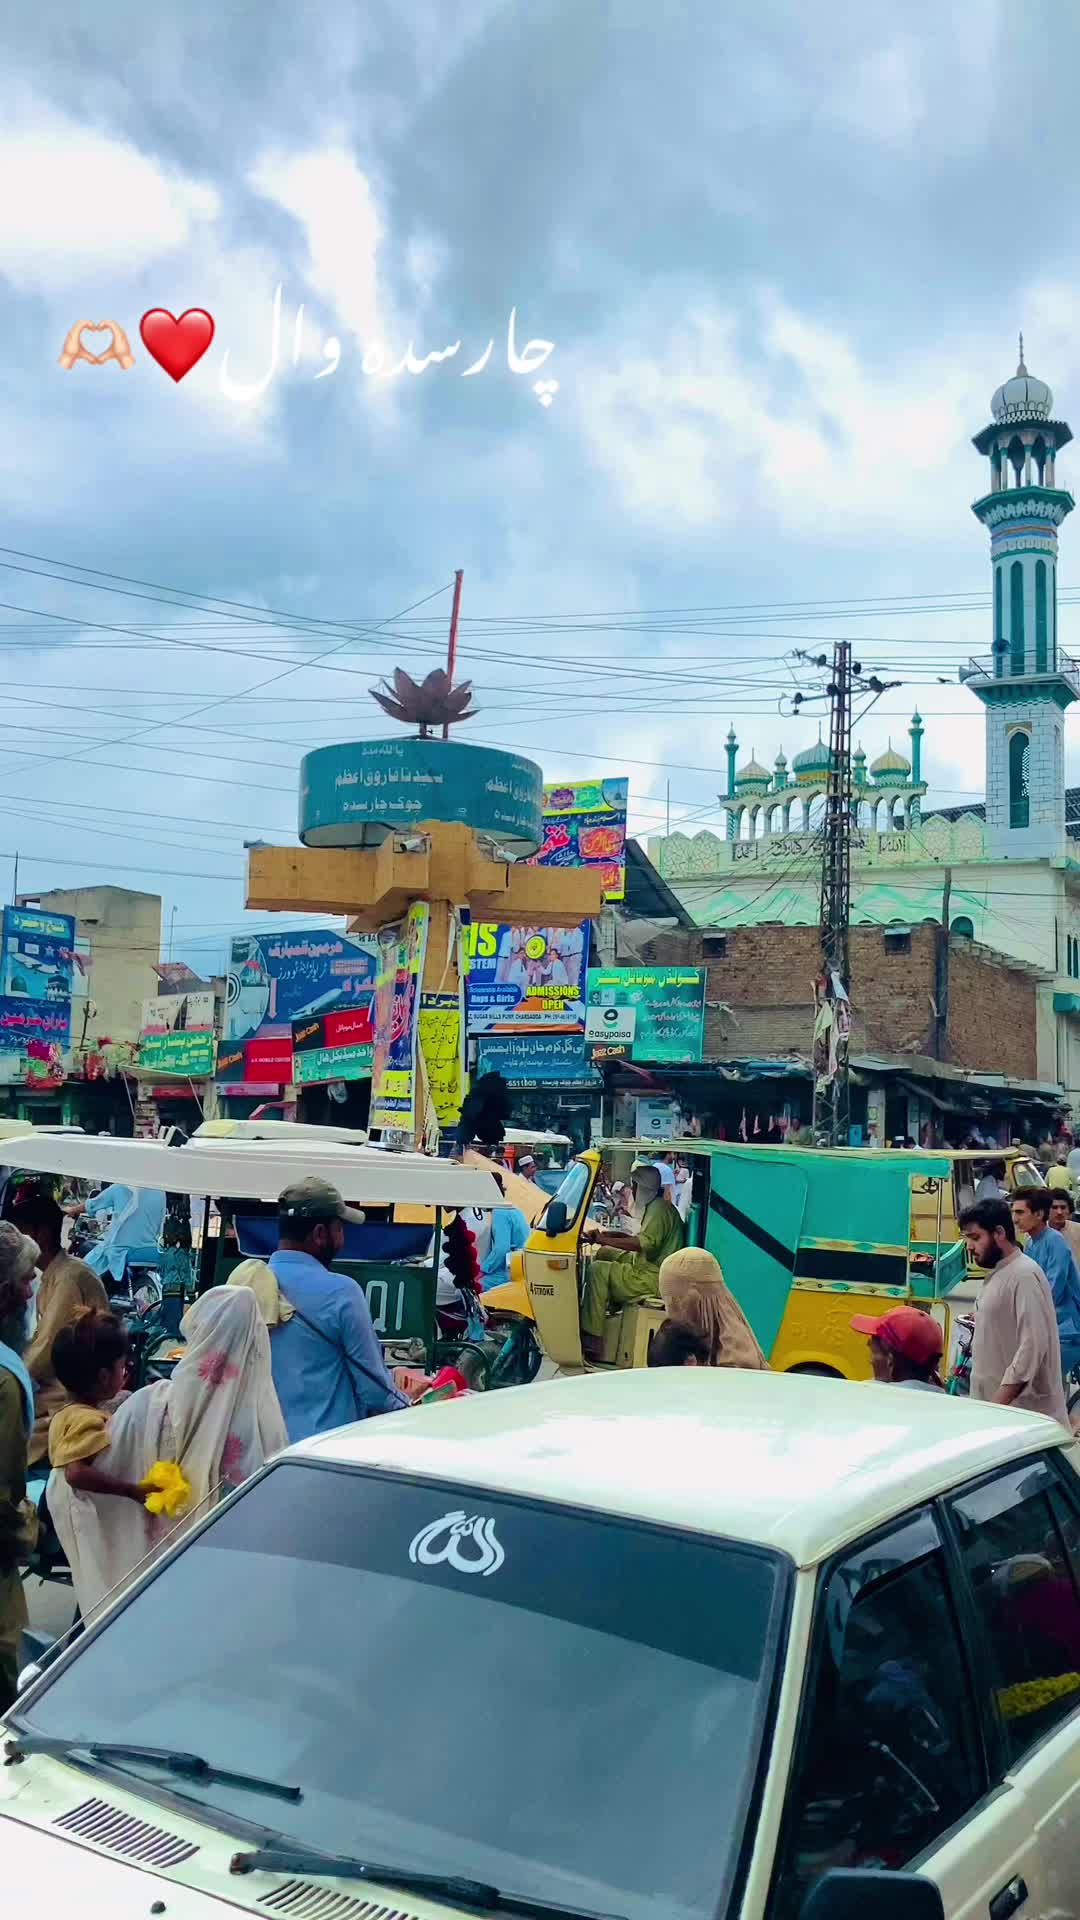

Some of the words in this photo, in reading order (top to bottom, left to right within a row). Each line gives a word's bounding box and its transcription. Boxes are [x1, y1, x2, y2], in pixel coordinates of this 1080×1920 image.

[389, 796, 423, 814] چوک
[526, 985, 581, 998] ADMISSIONS
[496, 994, 515, 1003] Girls
[542, 1000, 564, 1010] OPEN
[588, 1030, 631, 1040] easypaisa
[607, 1044, 625, 1056] Cash
[534, 1287, 555, 1296] STROKE
